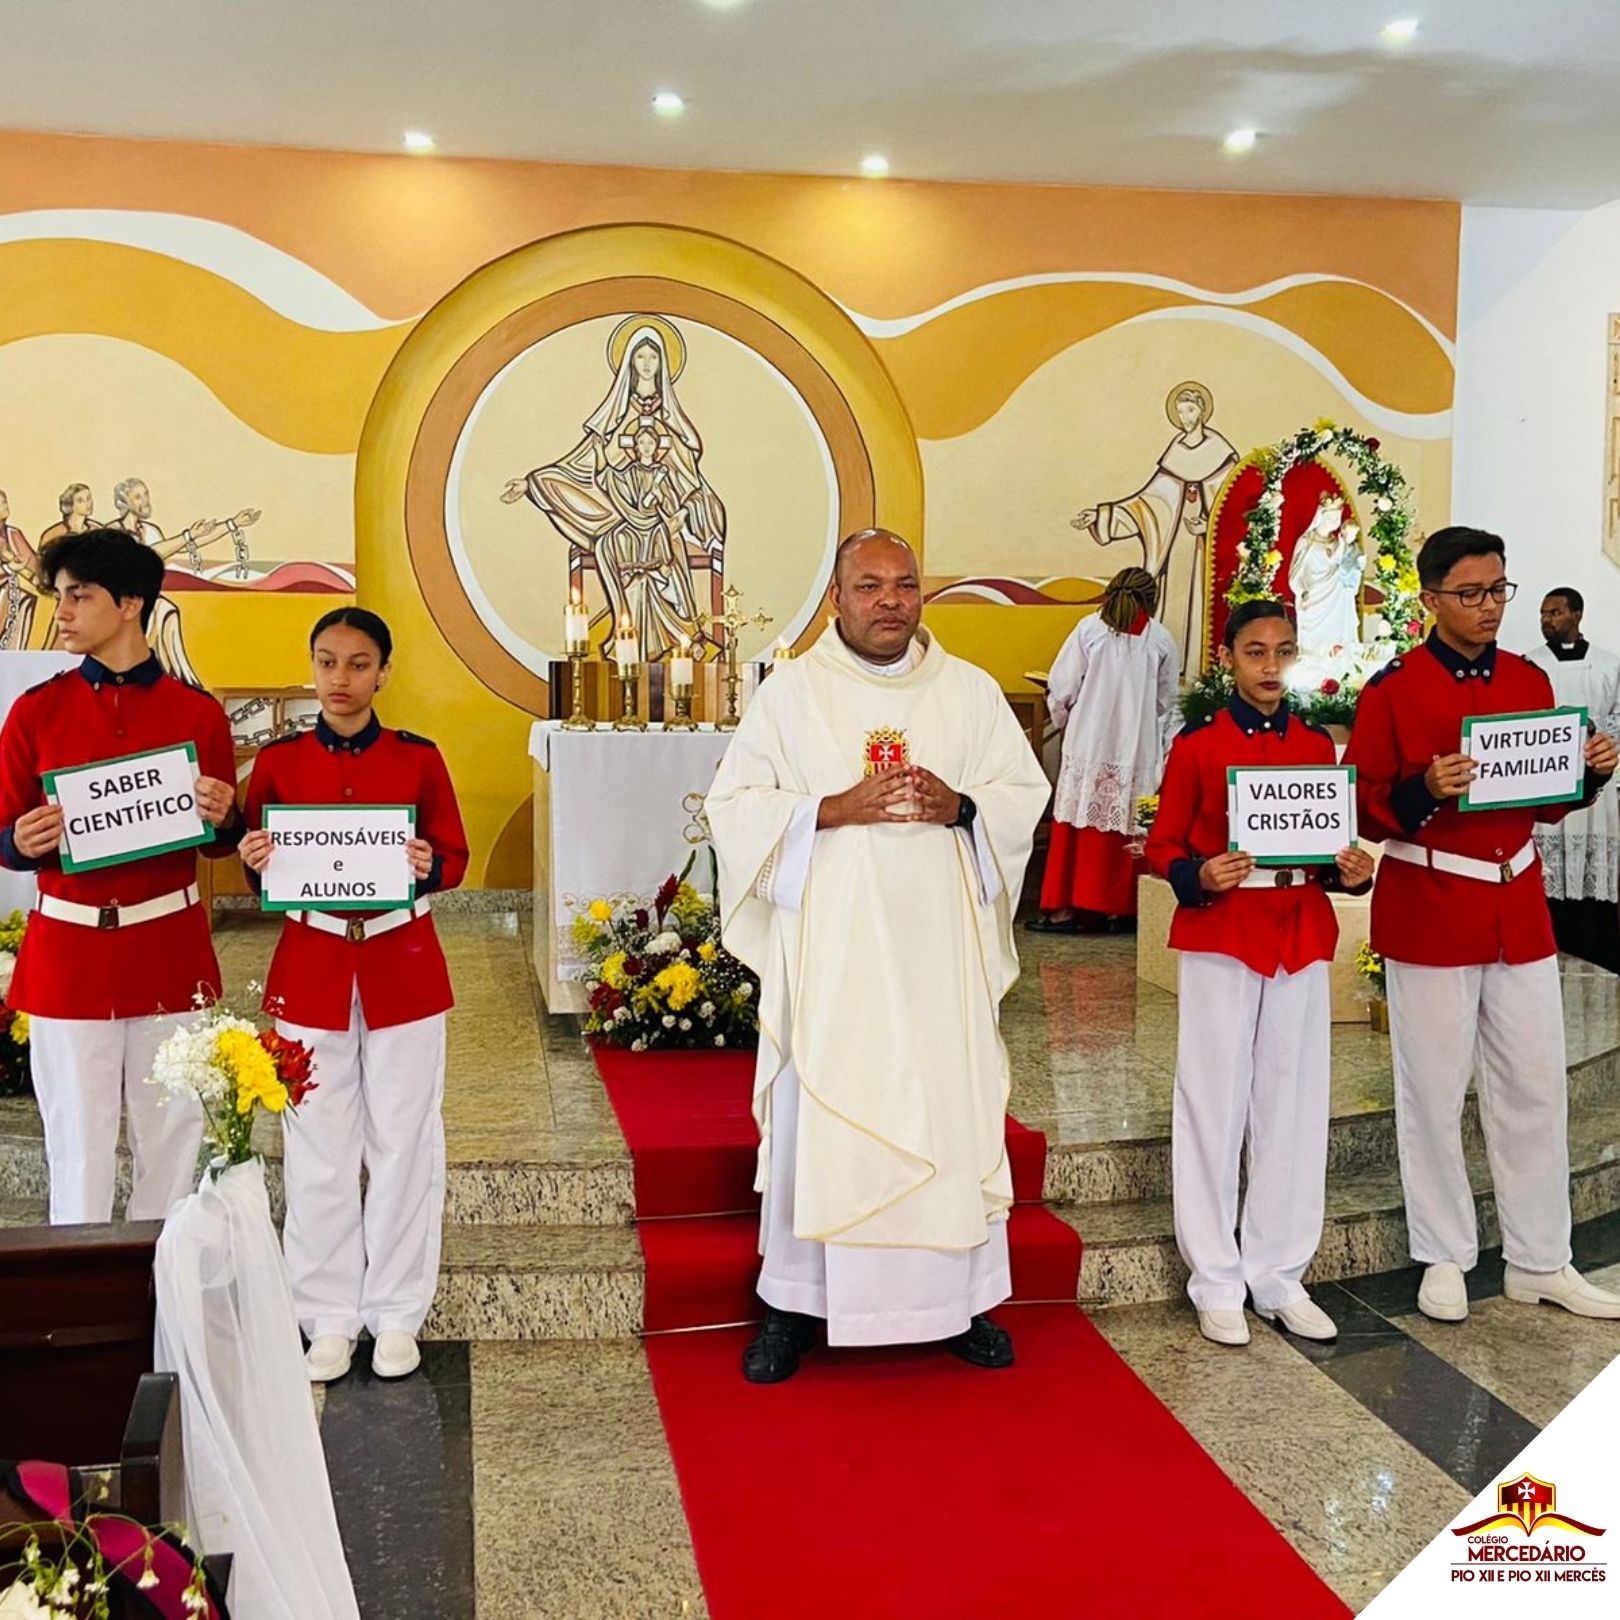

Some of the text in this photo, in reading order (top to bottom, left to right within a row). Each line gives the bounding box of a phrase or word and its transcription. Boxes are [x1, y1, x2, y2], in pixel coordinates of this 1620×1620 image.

[1479, 726, 1572, 751] VIRTUDES
[1480, 754, 1570, 779] FAMILIAR
[88, 768, 163, 800] SABER
[1249, 782, 1337, 800] VALORES
[69, 792, 194, 837] CIENTÍFICO
[1247, 807, 1341, 831] CRISTÃOS
[271, 826, 407, 846] RESPONSÁVEIS
[333, 859, 344, 872] e
[300, 882, 376, 897] ALUNOS
